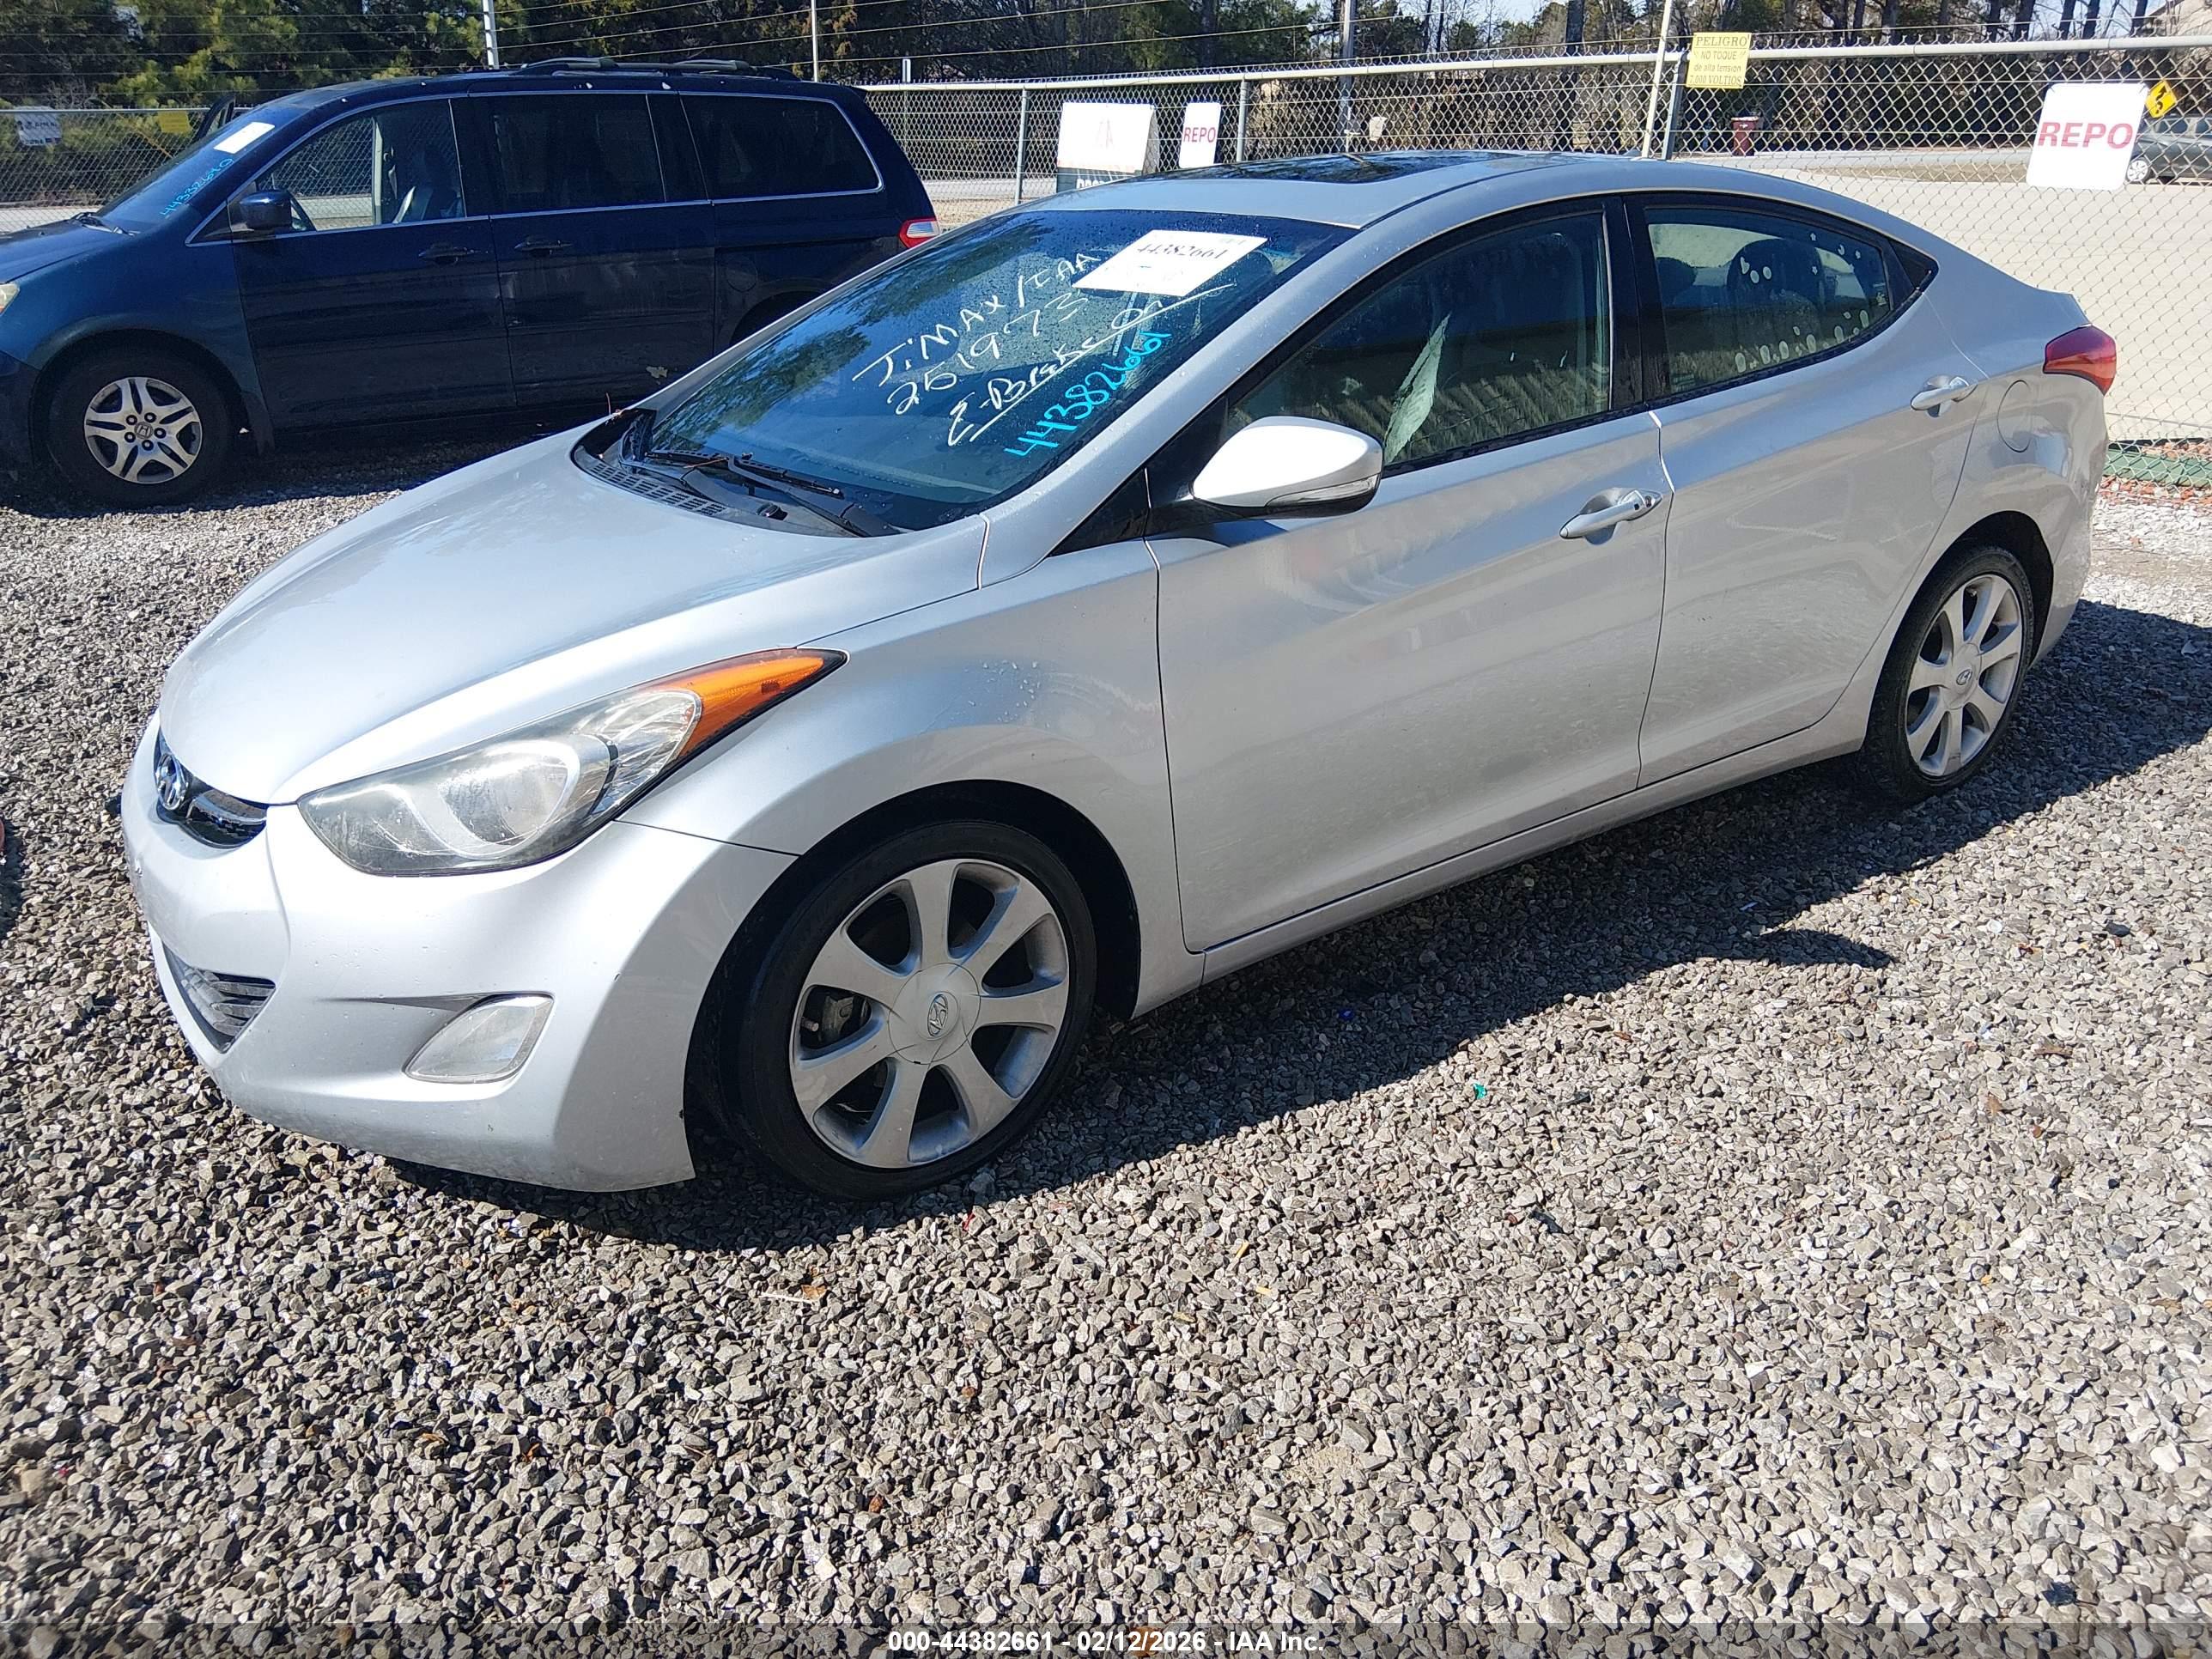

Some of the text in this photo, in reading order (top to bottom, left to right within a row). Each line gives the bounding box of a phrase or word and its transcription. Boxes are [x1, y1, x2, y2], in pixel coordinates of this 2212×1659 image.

[1696, 36, 1747, 46] PELIGRO
[1701, 52, 1737, 60] NO TOQUE
[1709, 76, 1742, 85] VOLTIOS
[1183, 126, 1216, 143] REPO
[2038, 122, 2134, 149] REPO
[886, 291, 1088, 415] 251973
[1003, 330, 1171, 457] 44382661
